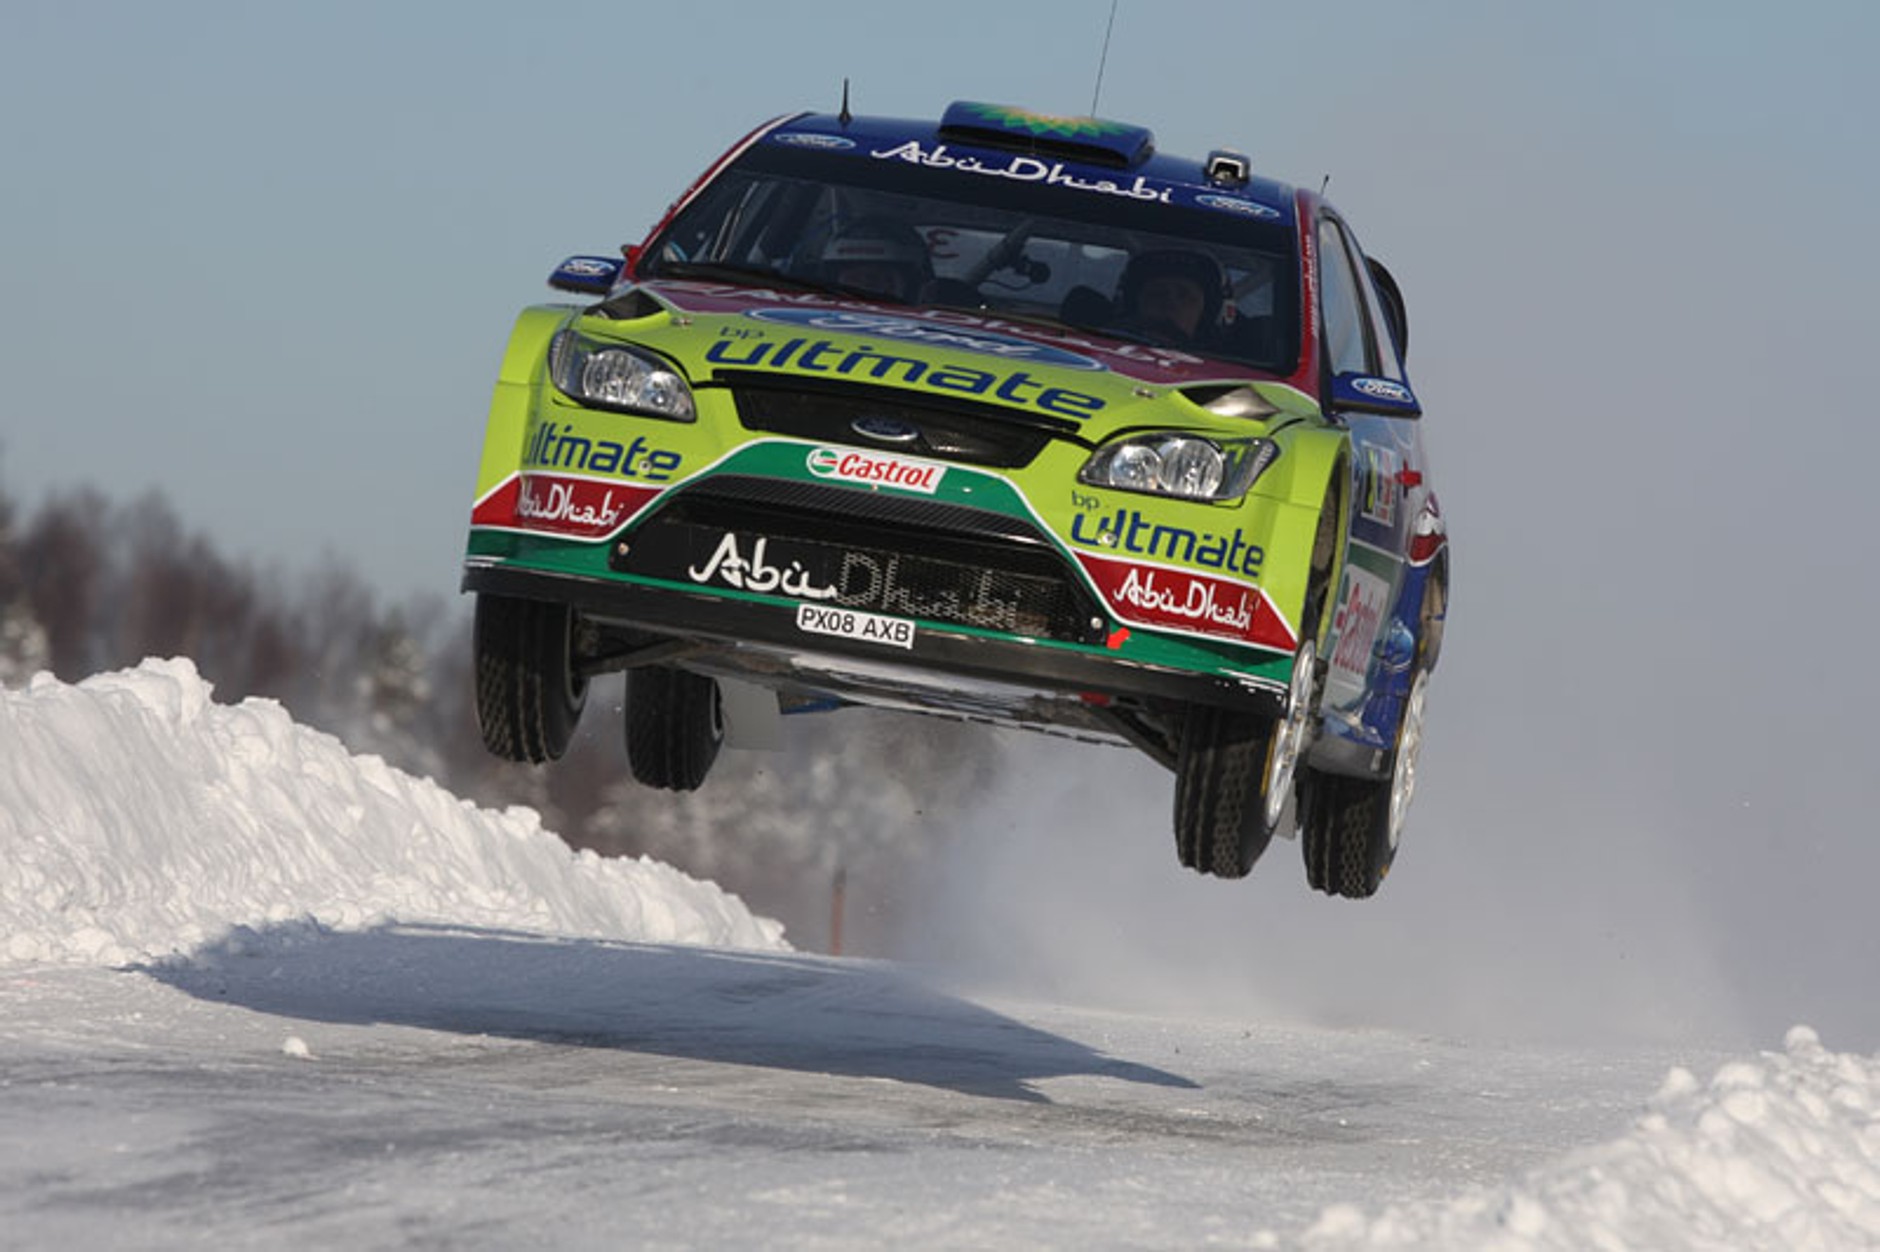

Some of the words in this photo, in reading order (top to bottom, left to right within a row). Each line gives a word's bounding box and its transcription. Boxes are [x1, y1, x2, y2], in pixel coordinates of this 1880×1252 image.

[705, 338, 1107, 419] ultimate
[838, 453, 935, 489] Castrol
[1071, 490, 1100, 511] bp
[688, 532, 838, 599] Abu
[1113, 568, 1185, 615] Abu
[801, 607, 855, 633] PX08
[862, 615, 911, 643] AXB
